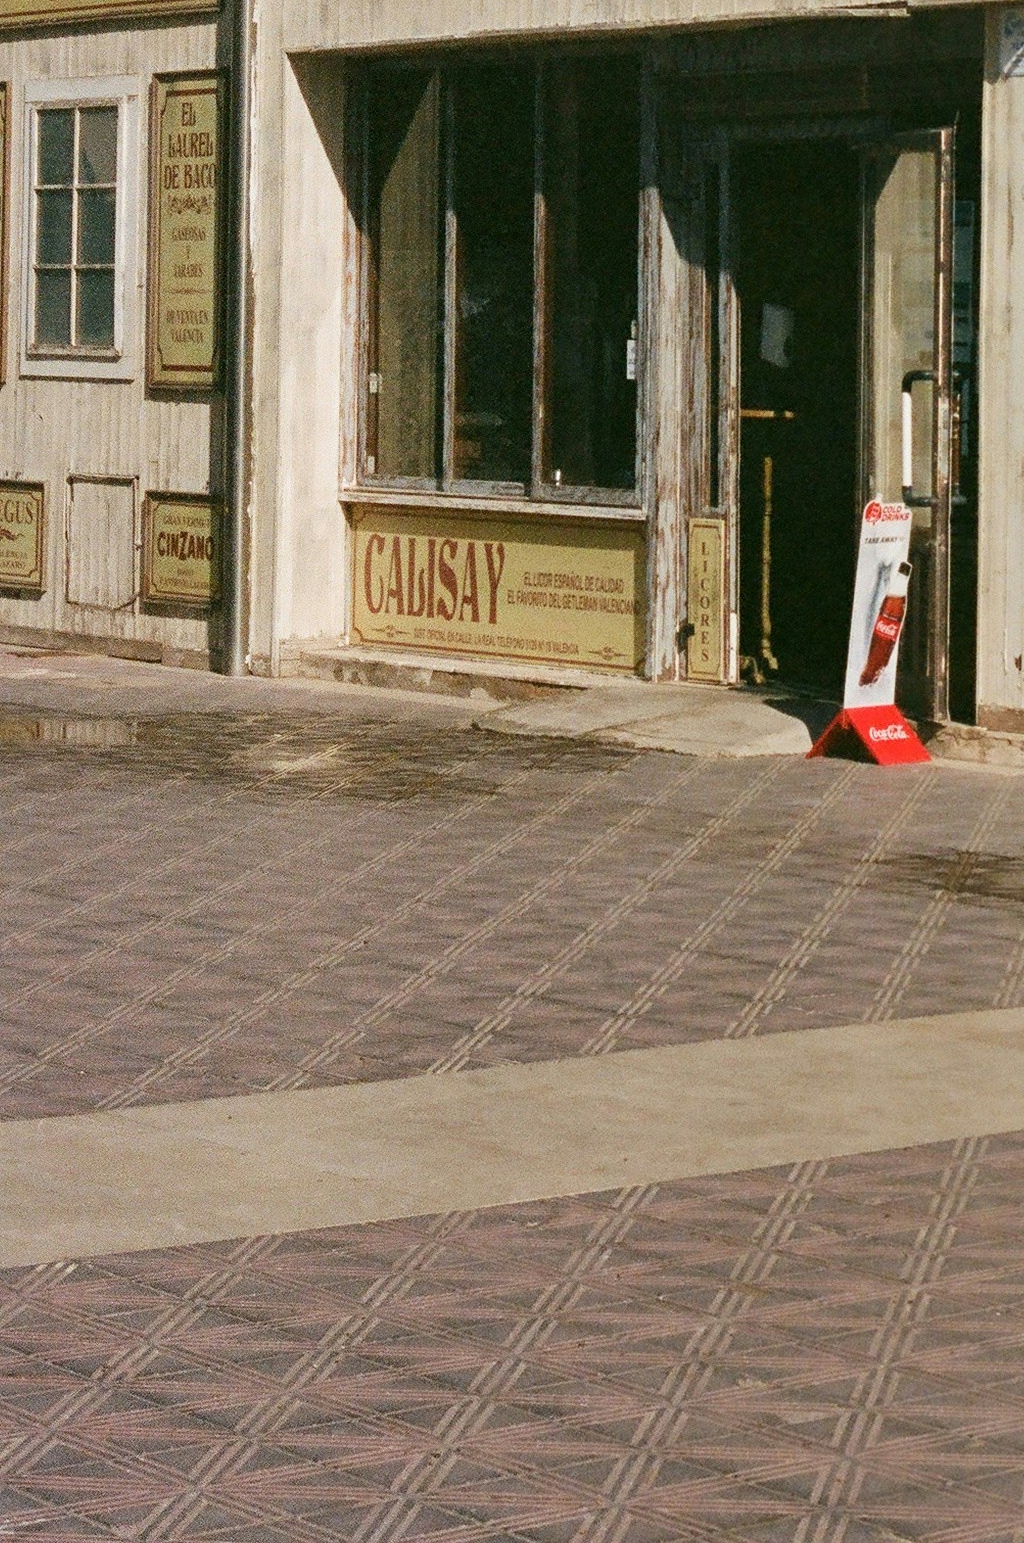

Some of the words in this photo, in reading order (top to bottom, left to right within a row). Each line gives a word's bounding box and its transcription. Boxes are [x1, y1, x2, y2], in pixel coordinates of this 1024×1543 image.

[182, 102, 196, 127] EL
[168, 131, 214, 158] LAUREL
[163, 164, 181, 190] DE
[184, 162, 217, 190] BACO
[882, 512, 910, 522] DRINKS
[883, 505, 902, 514] COLD
[157, 531, 215, 561] CINZANO
[865, 537, 880, 545] TAKE
[881, 536, 898, 544] AWAY
[364, 534, 506, 625] CALISAY
[535, 572, 552, 589] LICOR
[554, 572, 584, 591] ESPAÑOL
[585, 575, 594, 592] DE
[595, 576, 624, 594] CALIDAD
[506, 588, 516, 605] EL
[516, 589, 548, 608] FAVORITO
[549, 592, 561, 609] DEL
[700, 541, 711, 664] LICORES
[869, 724, 910, 742] Coca-Cola
